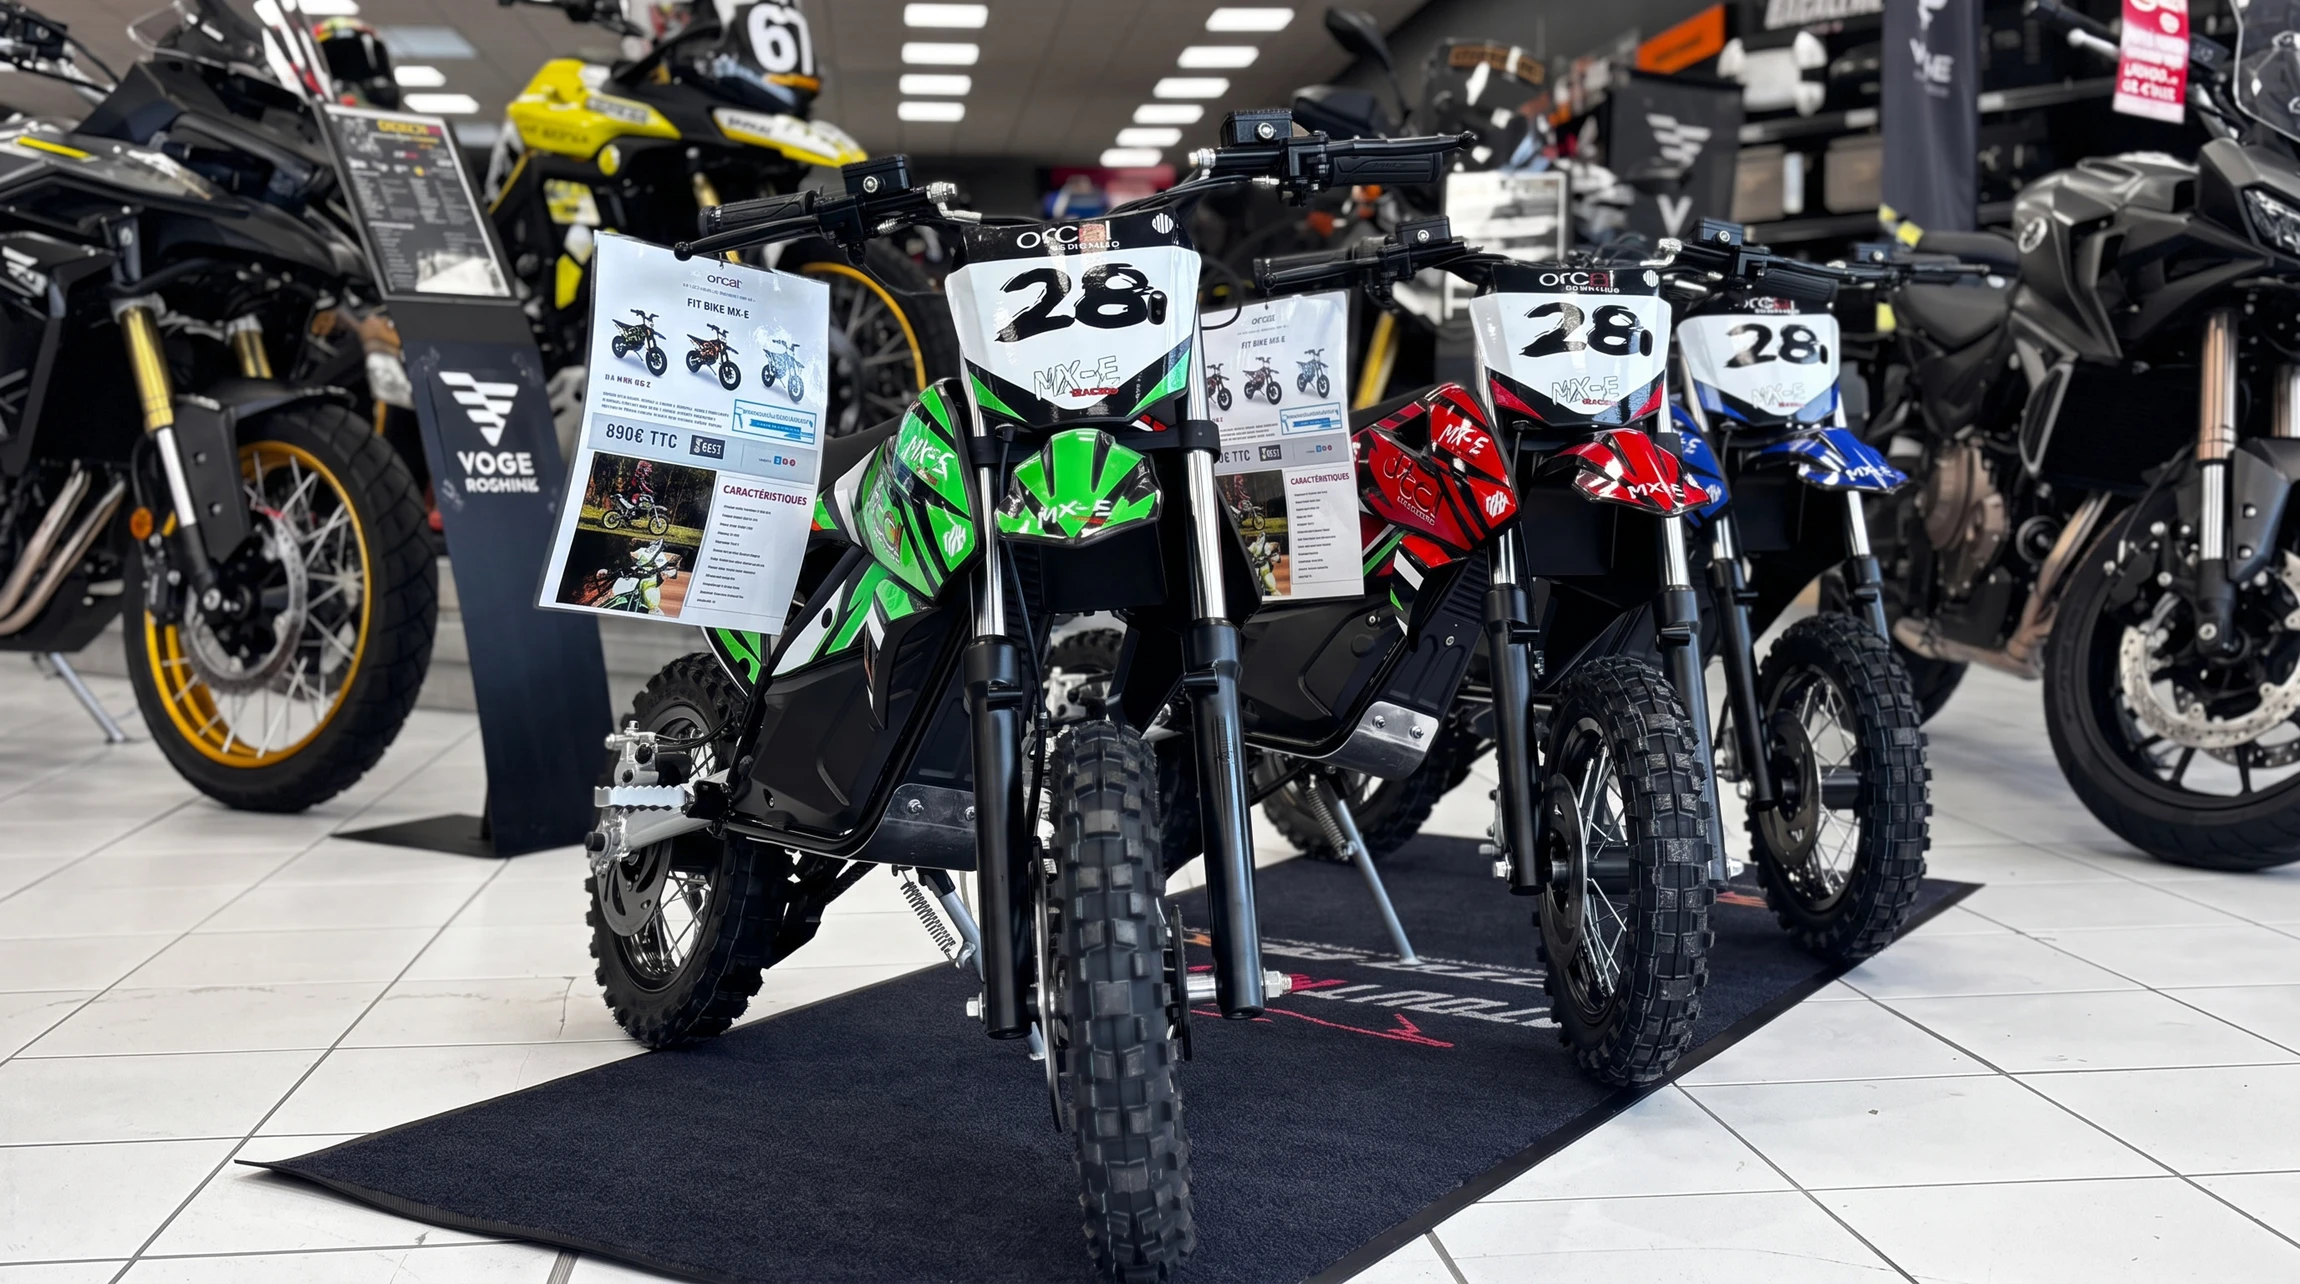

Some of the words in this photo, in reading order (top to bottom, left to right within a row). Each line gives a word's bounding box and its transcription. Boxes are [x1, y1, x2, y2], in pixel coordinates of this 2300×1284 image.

[687, 297, 702, 309] FIT
[703, 301, 725, 314] BIKE
[994, 262, 1150, 343] 28
[1518, 301, 1643, 358] 28
[1723, 322, 1818, 368] 28
[606, 422, 645, 444] 890€
[650, 430, 678, 449] TTC
[1438, 423, 1489, 456] MX-E
[456, 450, 535, 476] VOGE
[1232, 449, 1251, 462] TTC
[1290, 472, 1350, 486] CARACTÉRISTIQUES
[723, 484, 808, 506] CARACTÉRISTIQUES
[1037, 499, 1113, 531] MX-E
